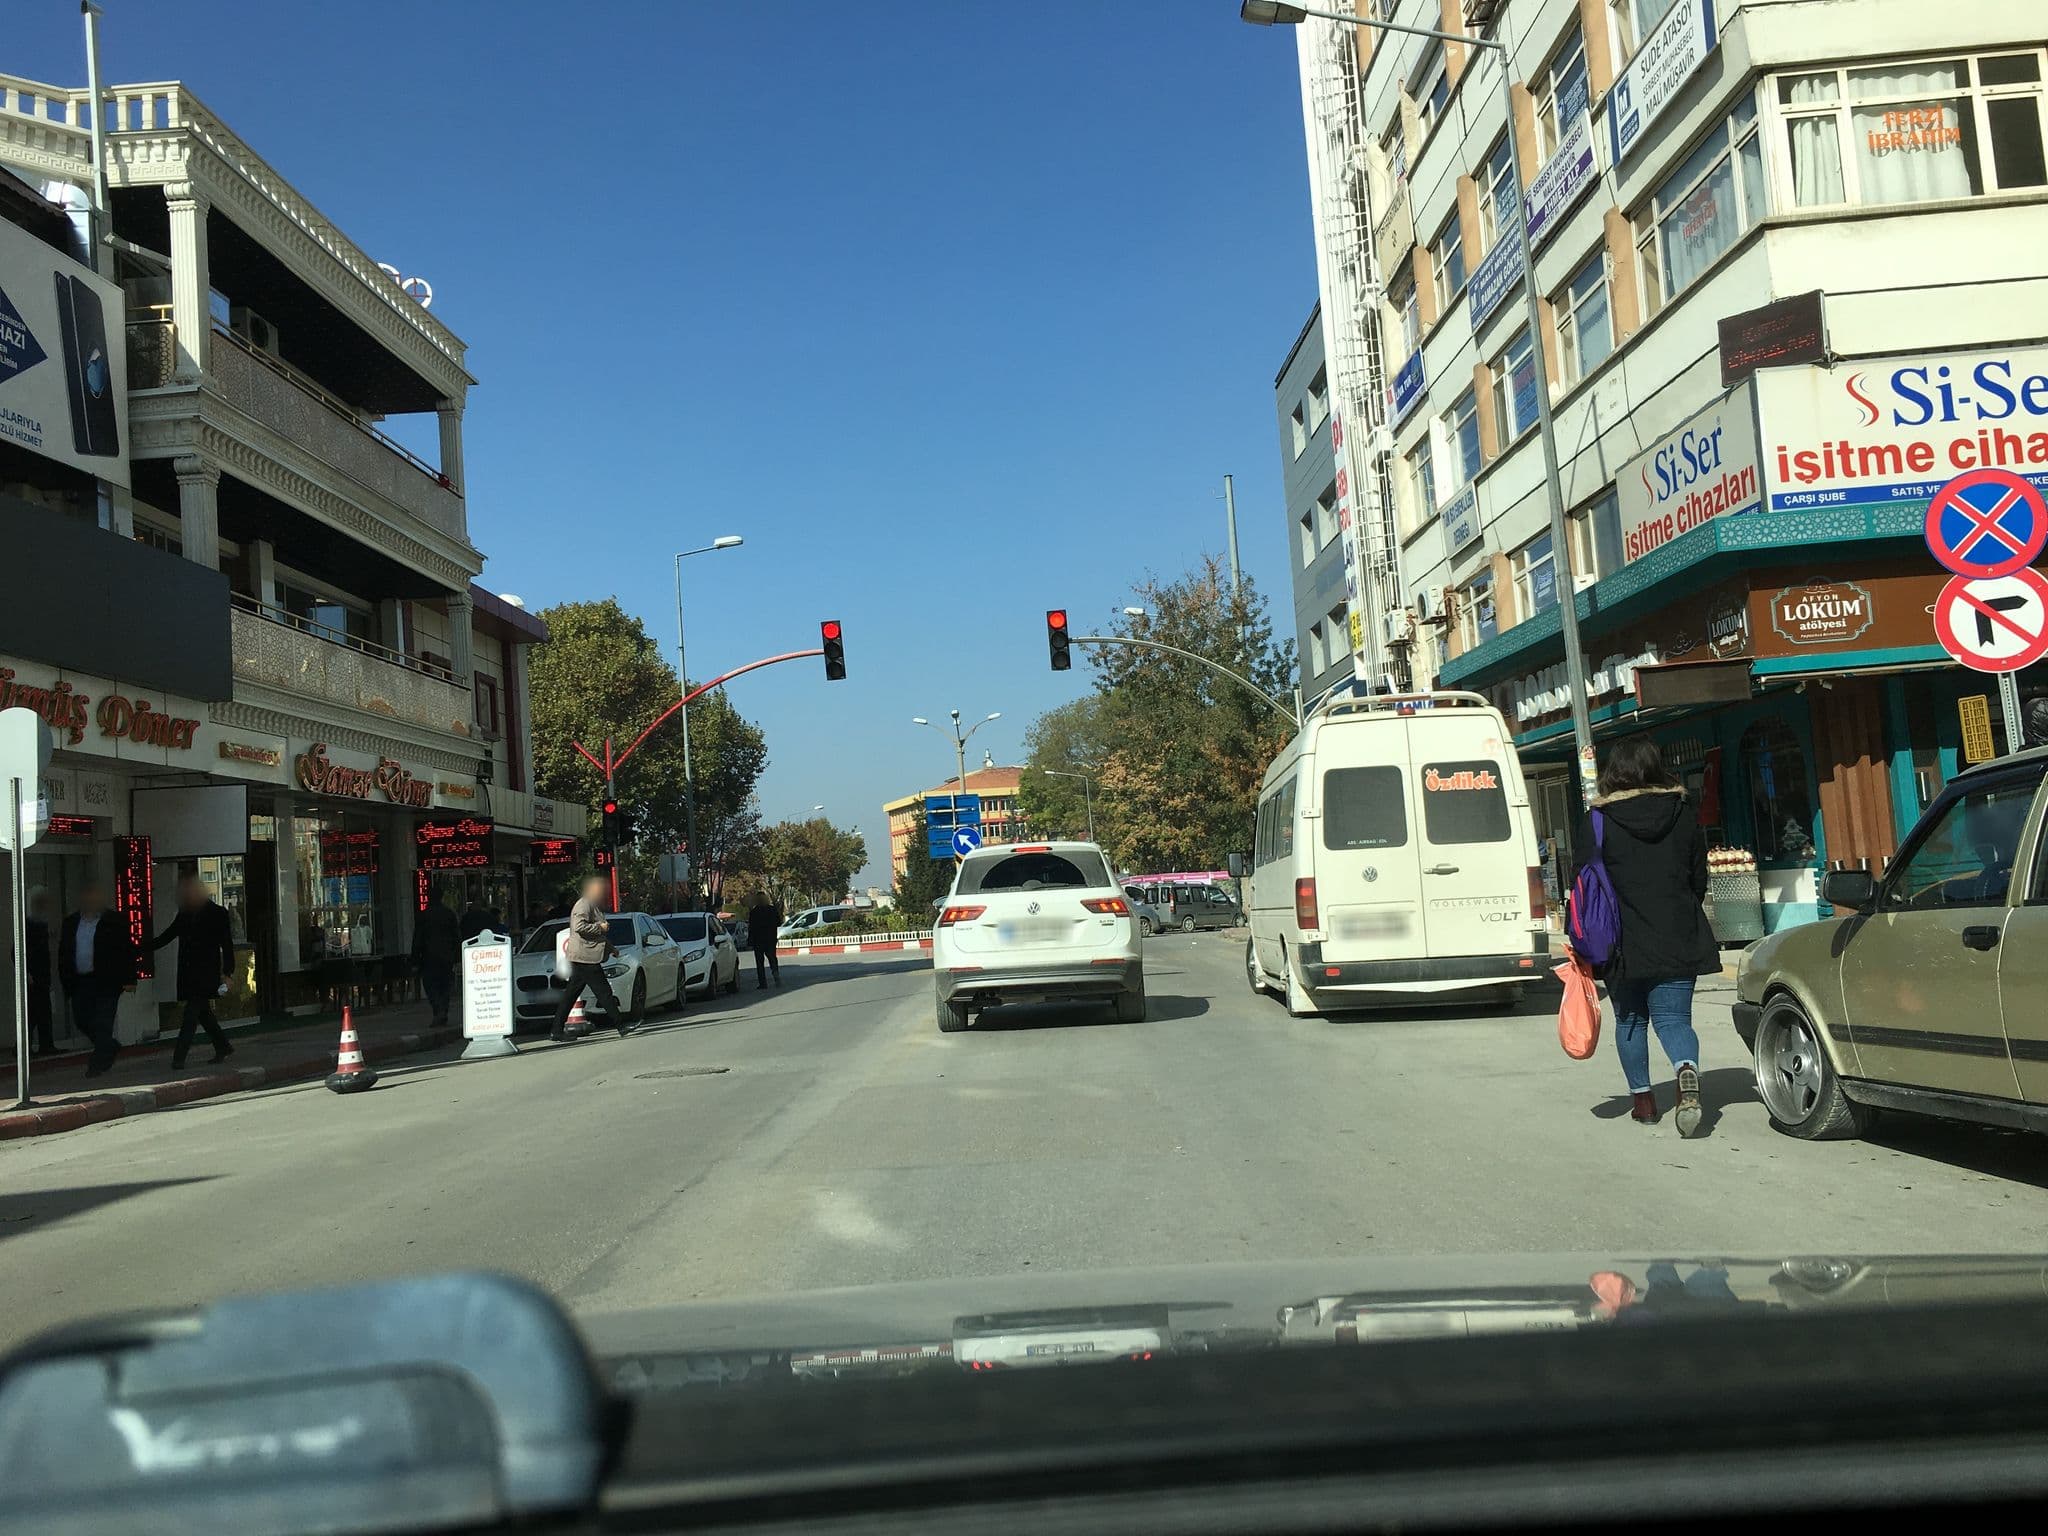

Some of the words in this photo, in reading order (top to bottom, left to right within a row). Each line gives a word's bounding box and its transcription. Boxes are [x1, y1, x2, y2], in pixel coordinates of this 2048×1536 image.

[1641, 38, 1660, 79] SUDE
[1662, 1, 1692, 50] ATASOY
[1646, 85, 1662, 118] MALİ
[1664, 47, 1695, 92] MÜŞAVİR
[1882, 101, 1944, 126] TERZİ
[1868, 127, 1961, 150] İBRAHİM
[1544, 183, 1567, 218] AHMET
[1567, 164, 1580, 188] ALP
[16, 428, 42, 448] HİZMET
[1654, 426, 1722, 504] Si-Ser
[1777, 440, 1935, 484] işitme
[1784, 495, 1816, 506] ÇARŞI
[1818, 492, 1846, 504] ŞUBE
[1891, 486, 1924, 497] SATIŞ
[1625, 514, 1673, 561] işitme
[1677, 464, 1756, 534] cihazları
[1802, 594, 1838, 603] AFYON
[1783, 600, 1861, 621] LOKUM
[1800, 618, 1847, 631] atölyesi
[96, 695, 200, 750] Döner
[1425, 768, 1497, 791] Özdilek
[598, 852, 612, 864] 31
[1434, 897, 1516, 908] VOLKSWAGEN
[1480, 912, 1522, 922] VOLT
[473, 963, 502, 974] Döner
